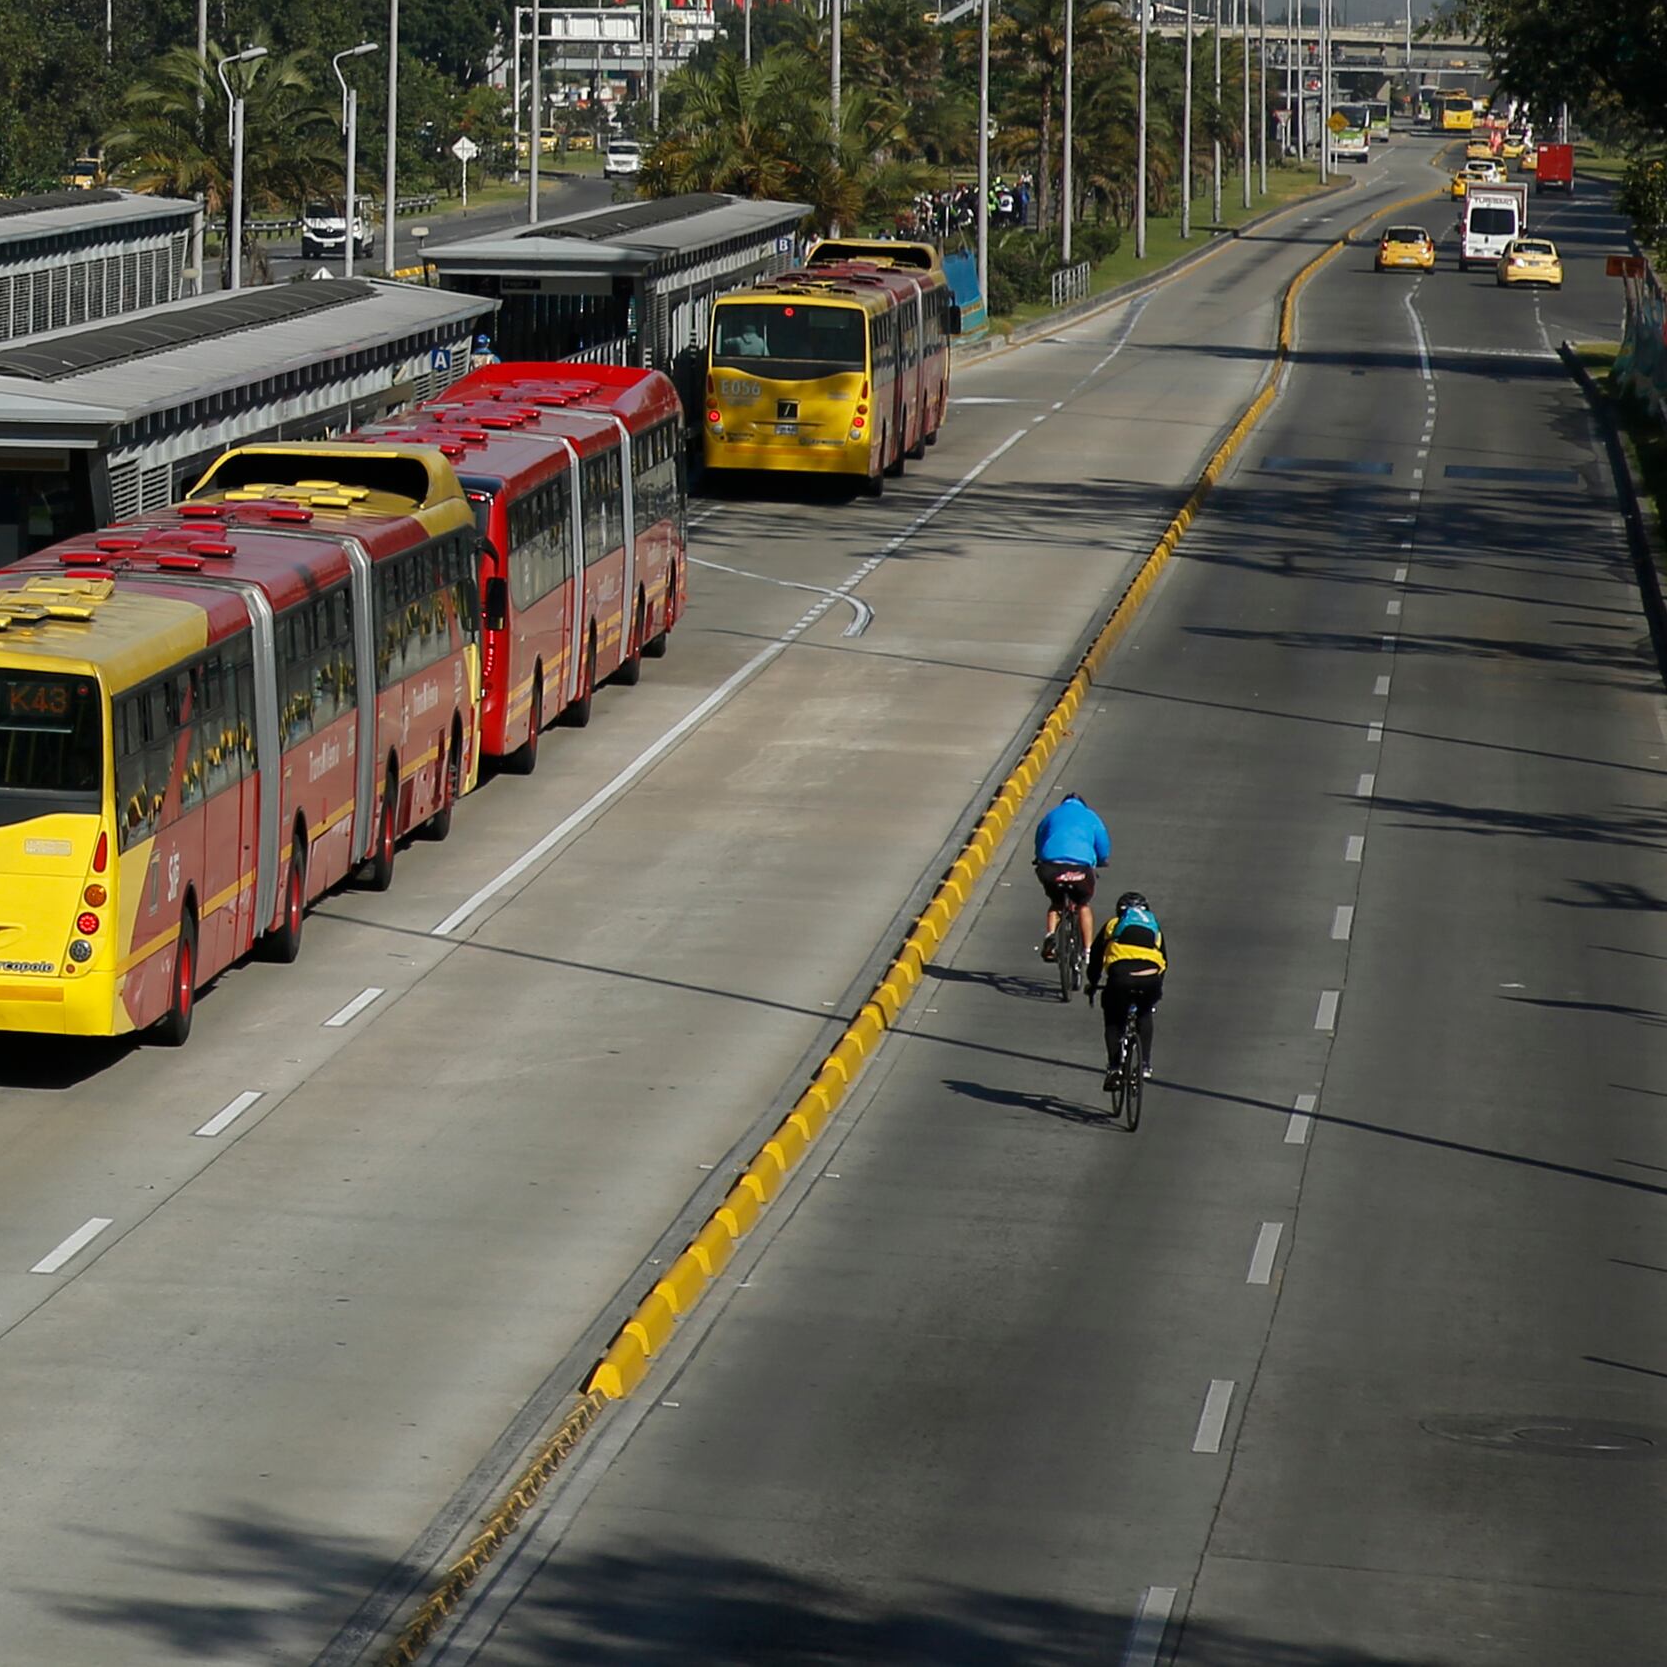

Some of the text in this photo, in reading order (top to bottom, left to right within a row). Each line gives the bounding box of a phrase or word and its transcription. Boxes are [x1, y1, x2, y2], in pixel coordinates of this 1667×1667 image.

[779, 239, 788, 251] B
[434, 351, 447, 368] A
[10, 686, 68, 714] K43
